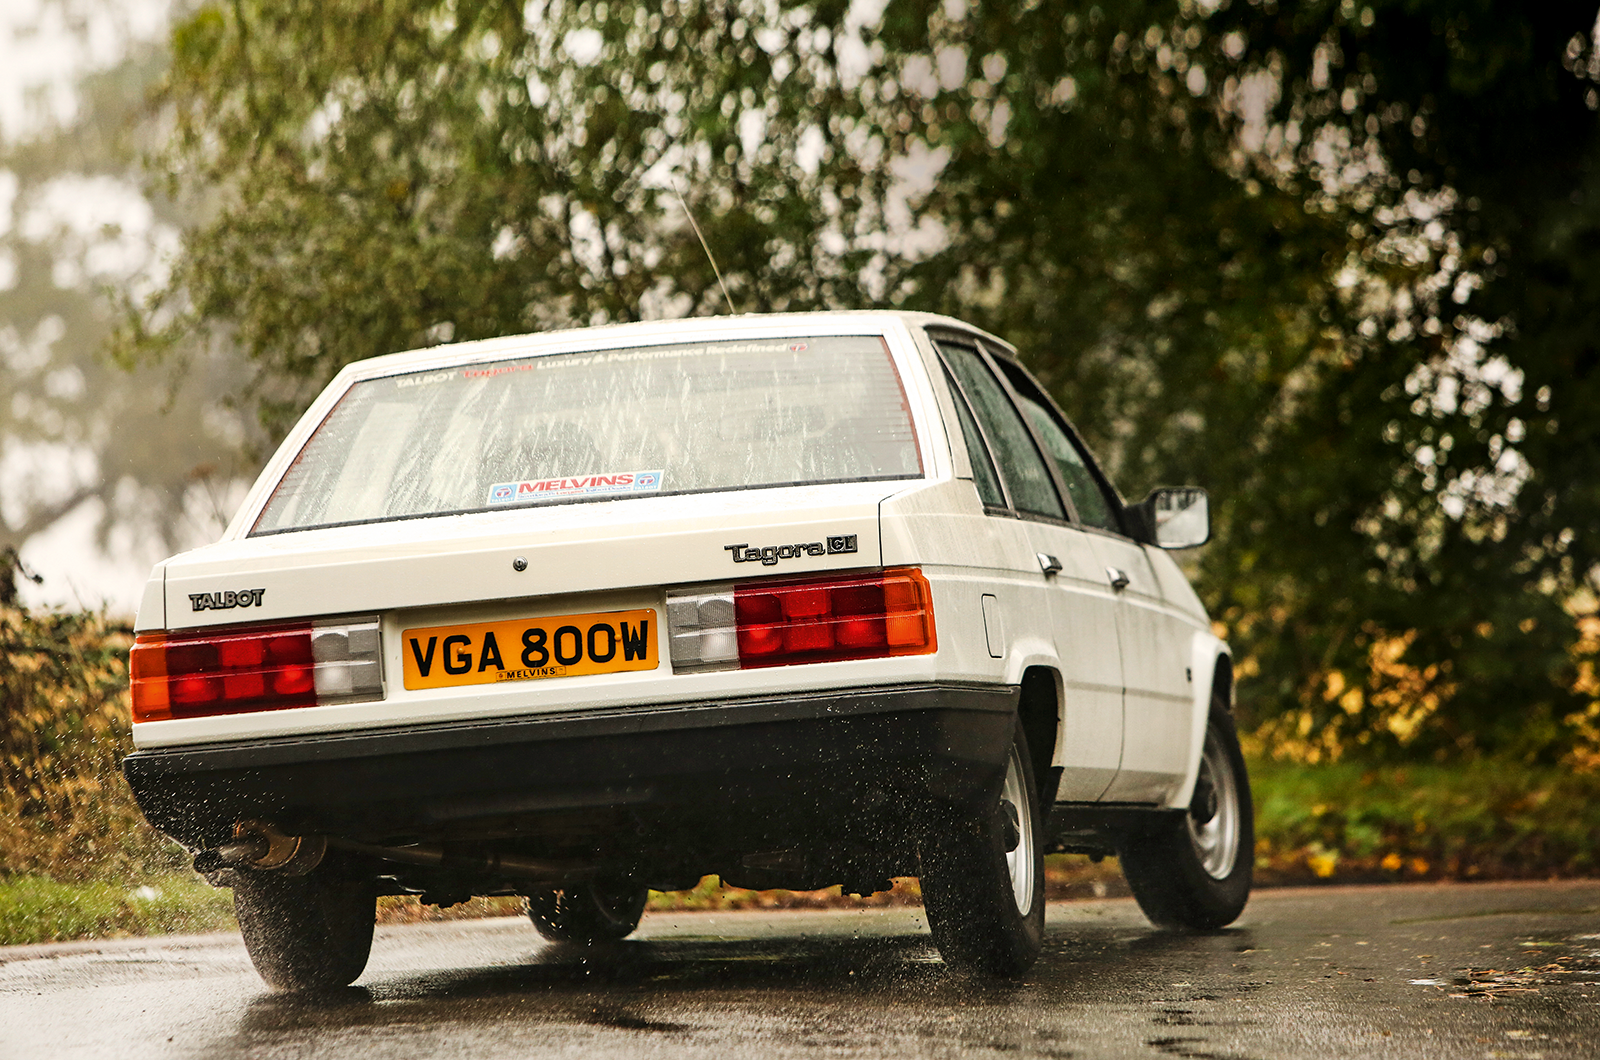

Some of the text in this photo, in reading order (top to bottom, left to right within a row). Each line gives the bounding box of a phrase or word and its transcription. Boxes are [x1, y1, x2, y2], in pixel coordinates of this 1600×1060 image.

[395, 371, 457, 388] TALBOT
[460, 363, 534, 378] Tagora
[537, 356, 593, 370] Luxury
[607, 348, 704, 362] Performance
[706, 343, 788, 355] Redefined
[518, 474, 634, 493] MELVINS
[724, 543, 825, 566] Tagora
[188, 588, 266, 611] TALBOT
[409, 620, 648, 677] VGA 800W
[507, 667, 556, 678] MELVINS
